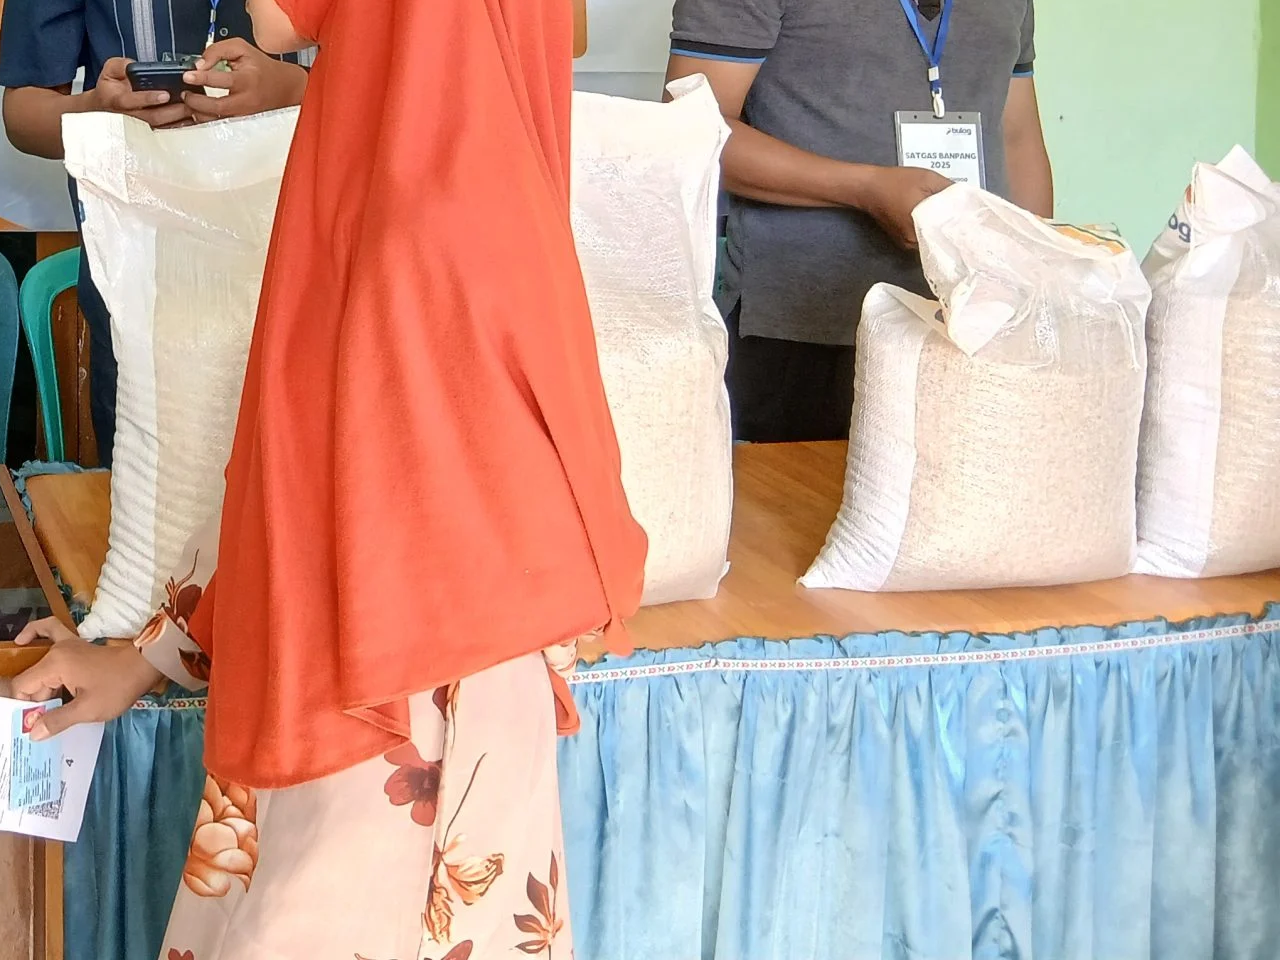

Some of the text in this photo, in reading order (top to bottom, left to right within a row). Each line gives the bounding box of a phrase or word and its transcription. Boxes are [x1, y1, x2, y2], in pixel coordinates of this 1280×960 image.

[951, 127, 972, 136] bulog
[905, 152, 977, 160] SATGAS BANPANG
[930, 161, 951, 169] 2025
